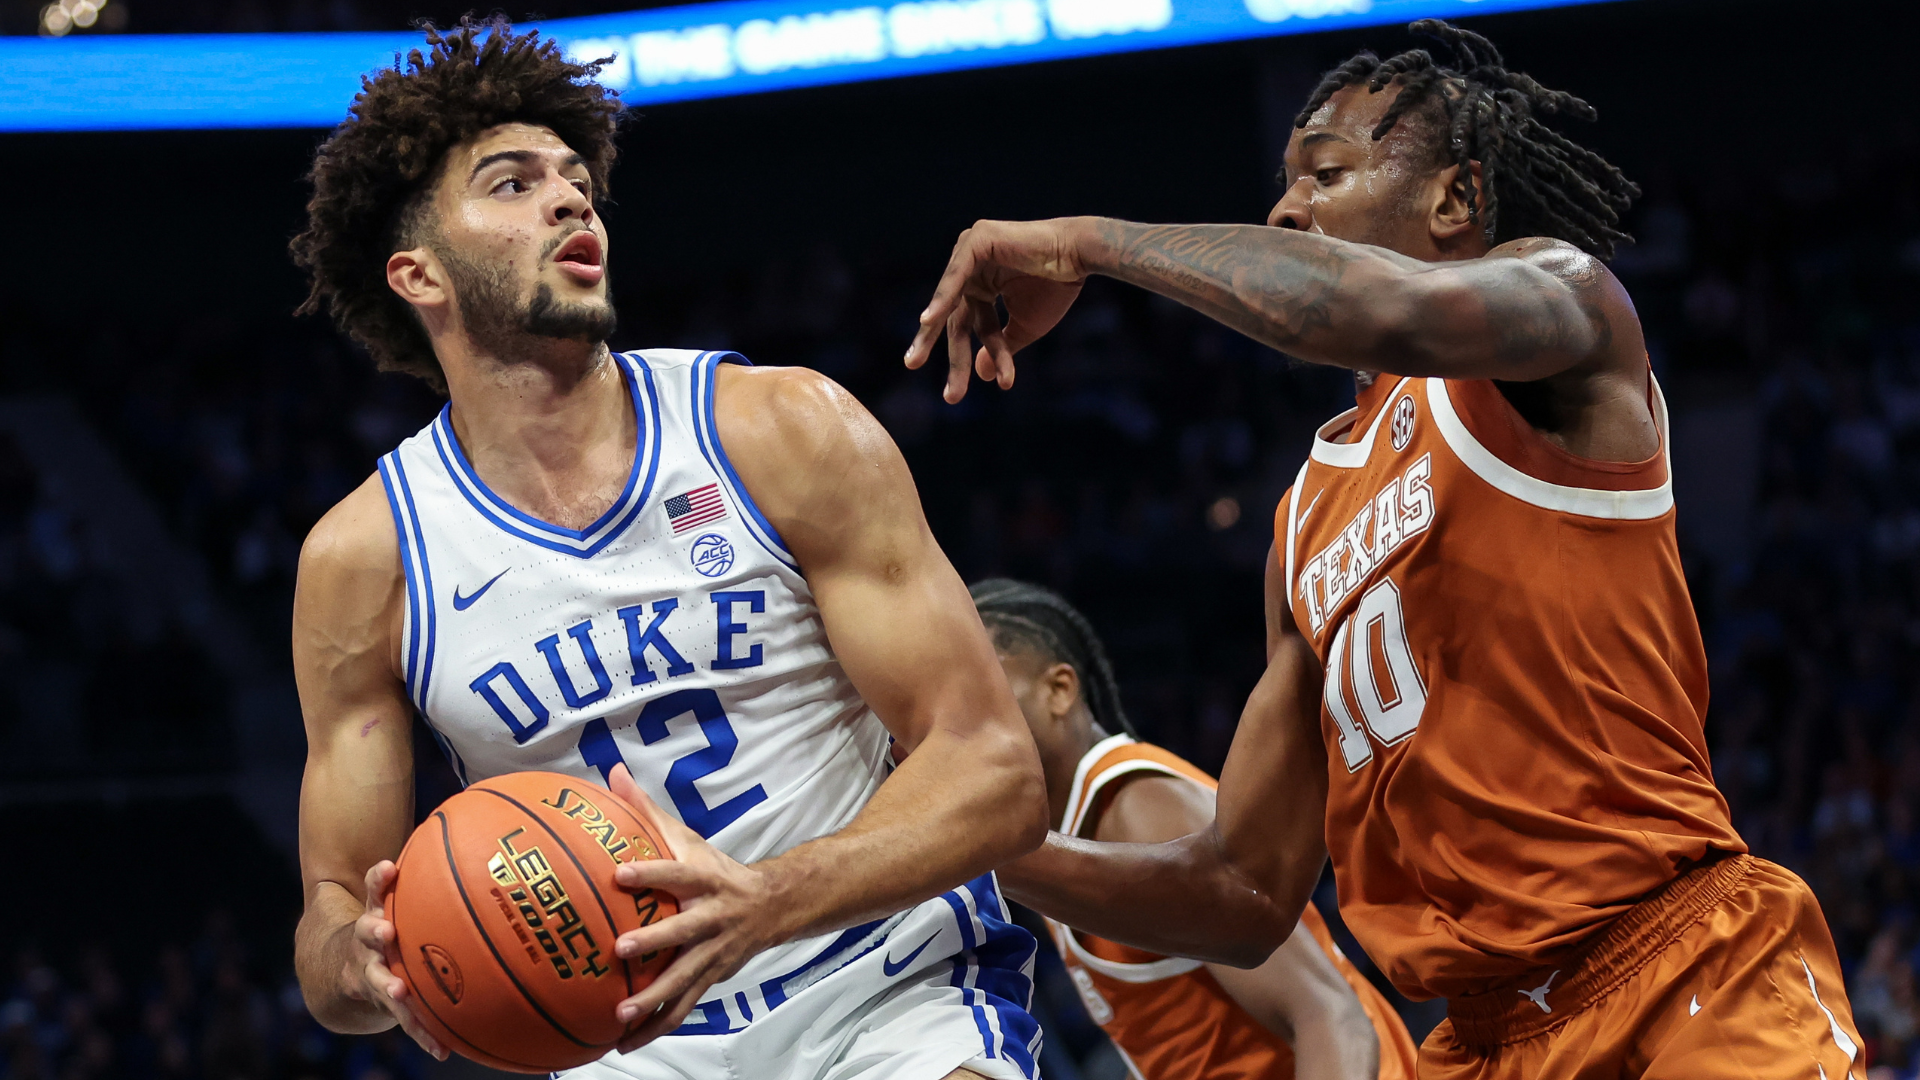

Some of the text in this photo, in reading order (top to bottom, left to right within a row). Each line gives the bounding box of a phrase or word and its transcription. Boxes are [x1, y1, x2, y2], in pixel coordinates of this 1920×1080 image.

[1392, 398, 1414, 449] SEC
[697, 541, 730, 562] ACC
[1299, 451, 1436, 640] TEXAS
[469, 590, 765, 745] DUKE
[1323, 575, 1429, 774] 10
[498, 825, 611, 980] LEGACY
[508, 886, 575, 980] 1000
